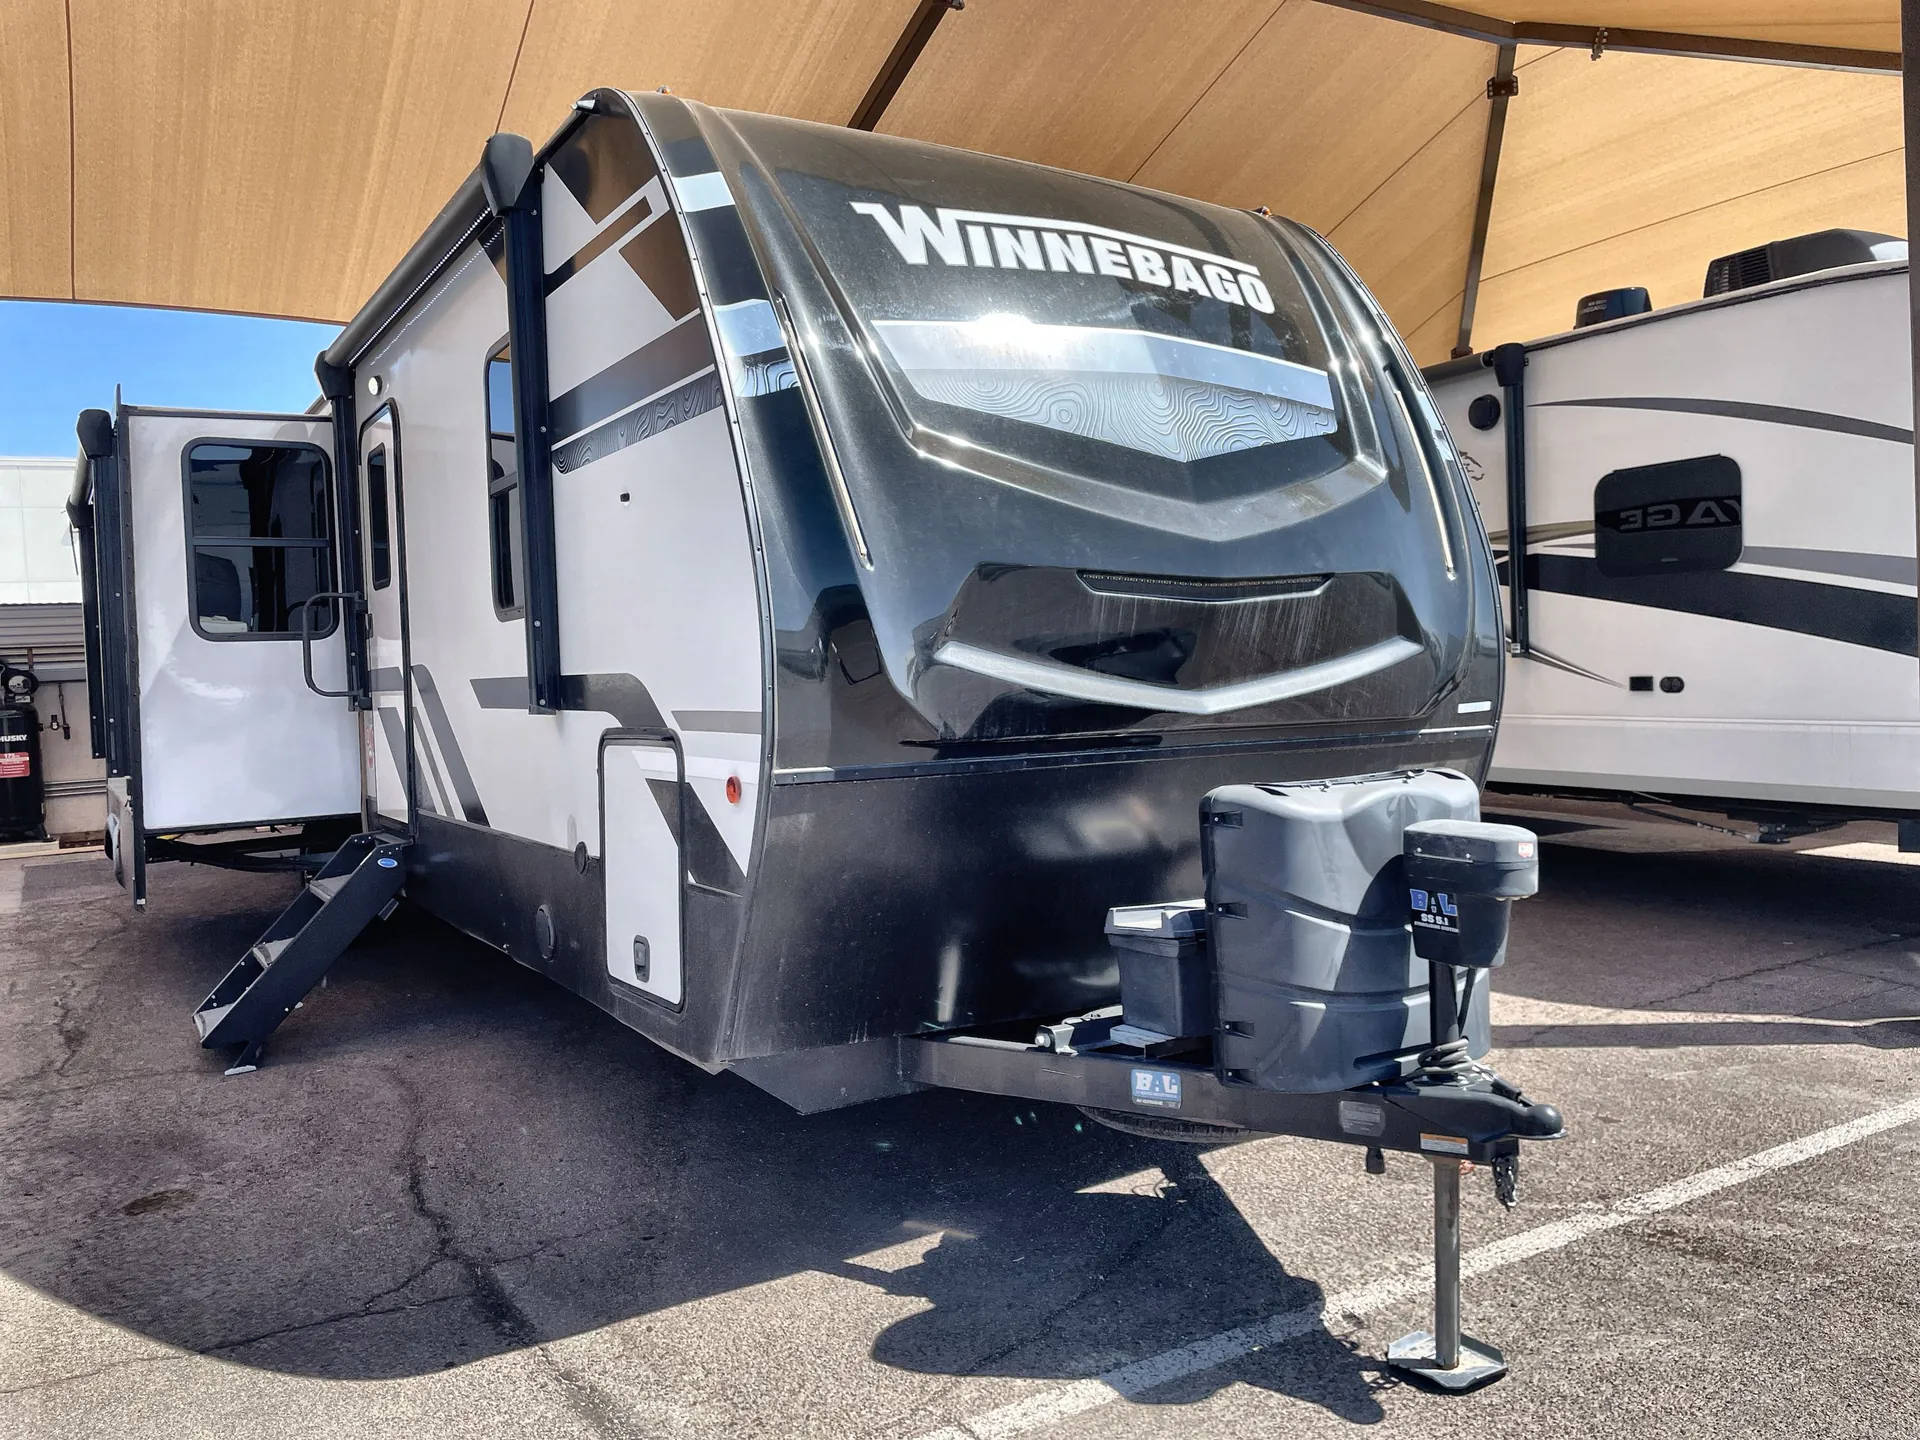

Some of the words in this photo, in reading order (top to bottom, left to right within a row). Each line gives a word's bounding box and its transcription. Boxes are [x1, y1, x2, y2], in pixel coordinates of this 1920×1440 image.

[850, 201, 1276, 315] WINNEBAGO
[1409, 888, 1458, 917] BAL
[1420, 913, 1435, 923] SS
[1435, 915, 1449, 926] 5.1
[1136, 1072, 1178, 1094] BAL
